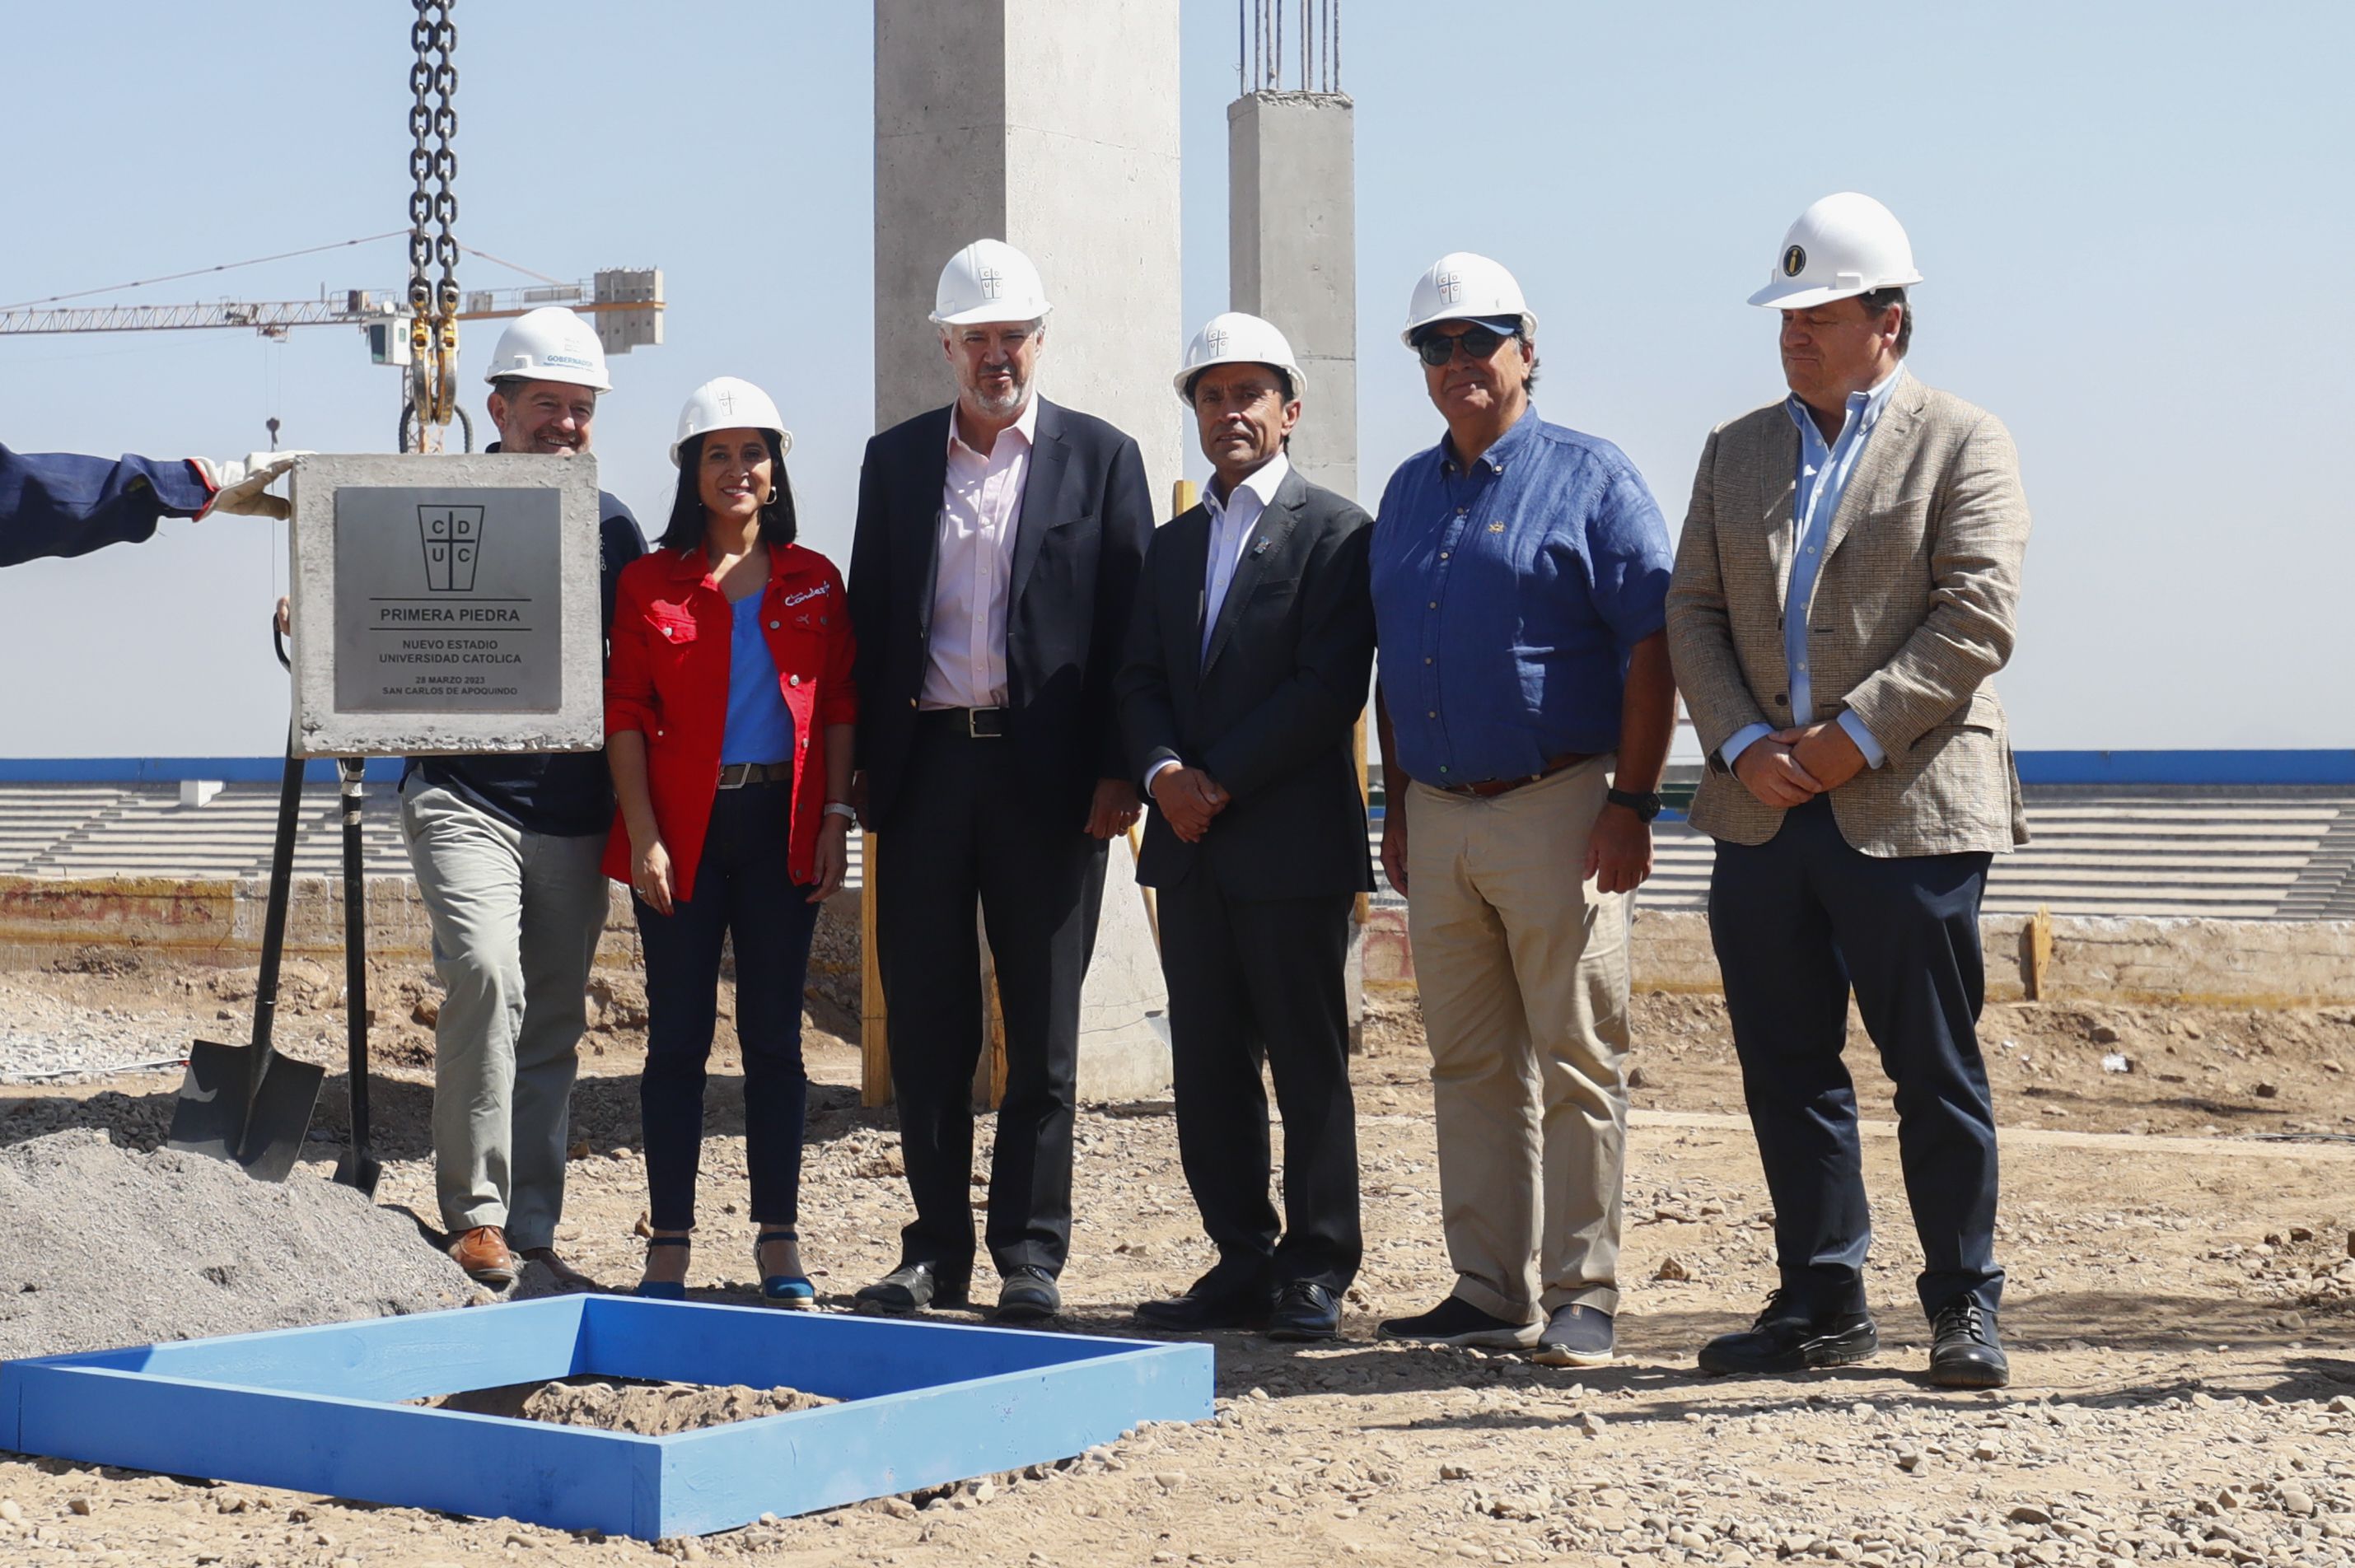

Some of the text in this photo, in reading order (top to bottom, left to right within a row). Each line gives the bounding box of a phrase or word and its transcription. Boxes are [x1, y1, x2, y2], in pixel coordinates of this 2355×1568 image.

[431, 520, 470, 534] C D
[432, 548, 470, 562] U C
[381, 609, 521, 622] PRIMERA PIEDRA
[402, 640, 498, 650] NUEVO ESTADIO
[379, 654, 522, 664] UNIVERSIDAD CATOLICA
[415, 676, 485, 684] 28 MARZO 2023
[382, 687, 518, 695] SAN CARLOS DE APOQUINDO
